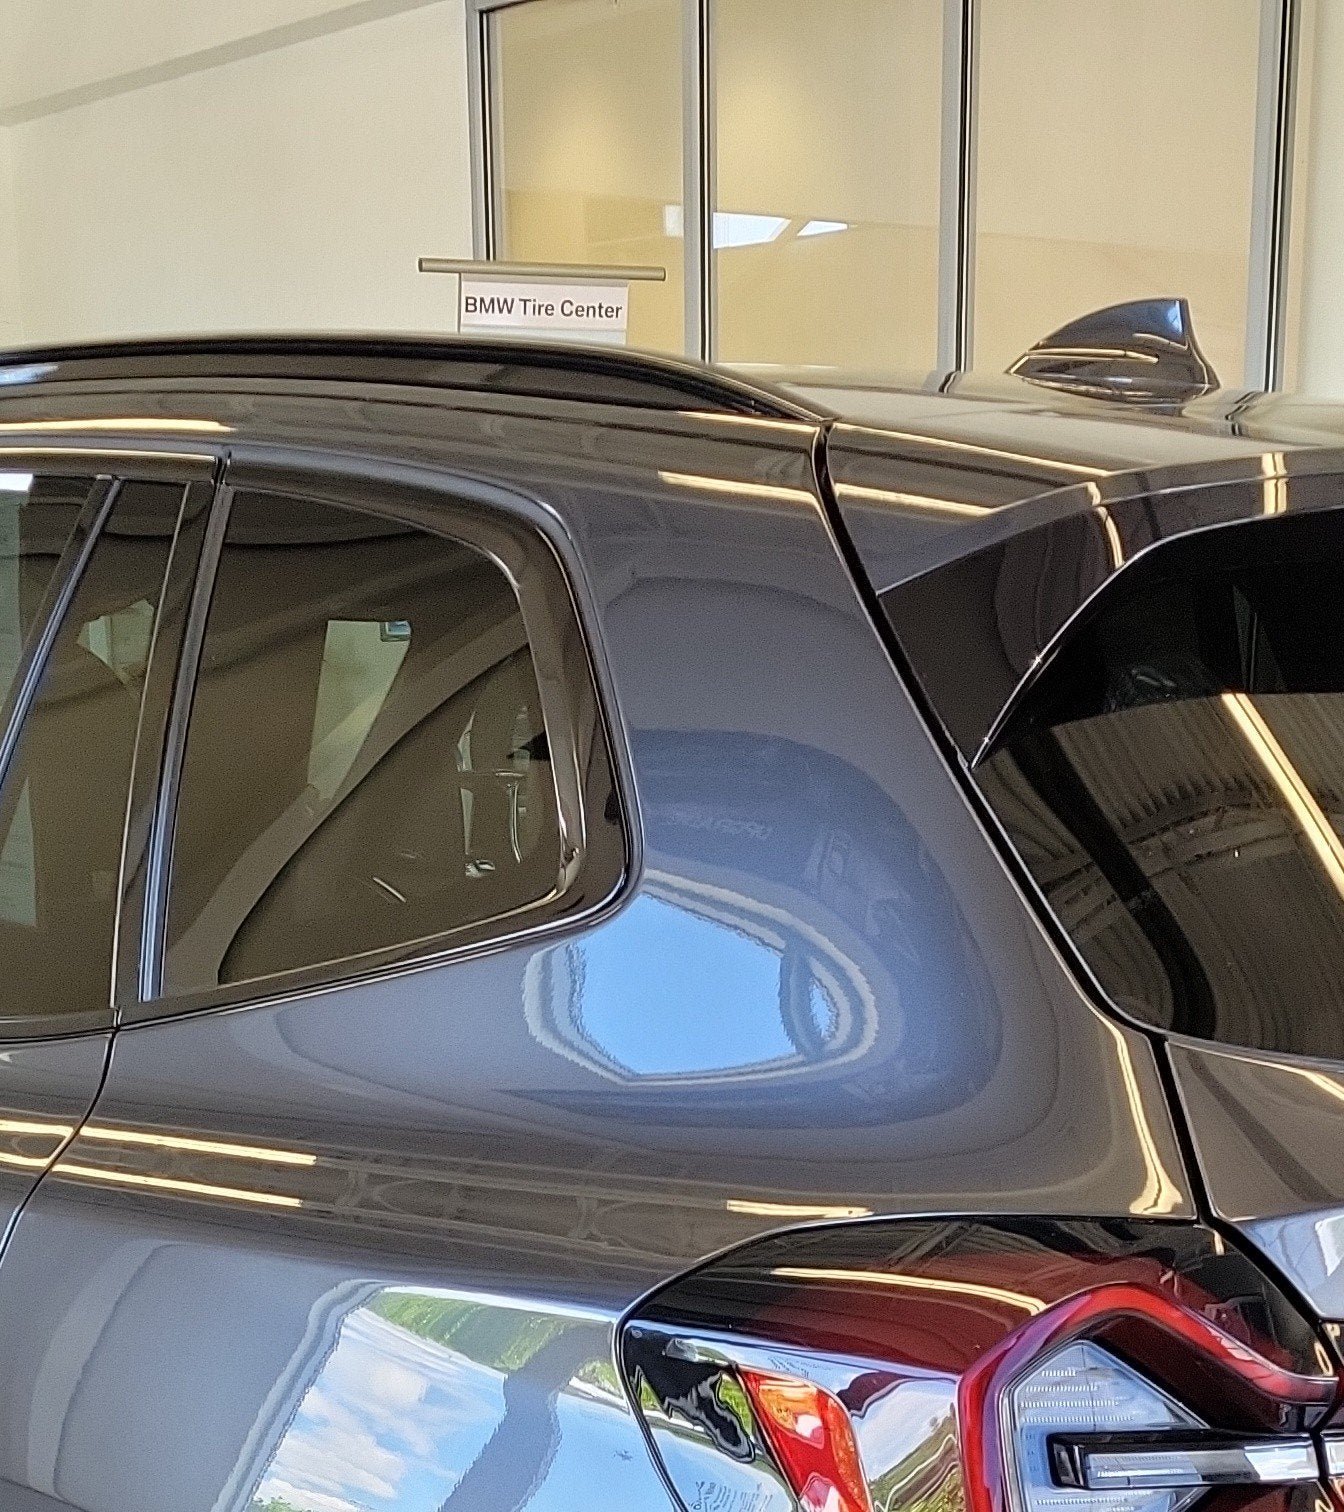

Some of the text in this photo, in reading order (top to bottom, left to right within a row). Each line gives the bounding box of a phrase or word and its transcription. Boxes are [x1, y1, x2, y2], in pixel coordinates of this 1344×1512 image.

[464, 295, 623, 319] BMW Tire Center
